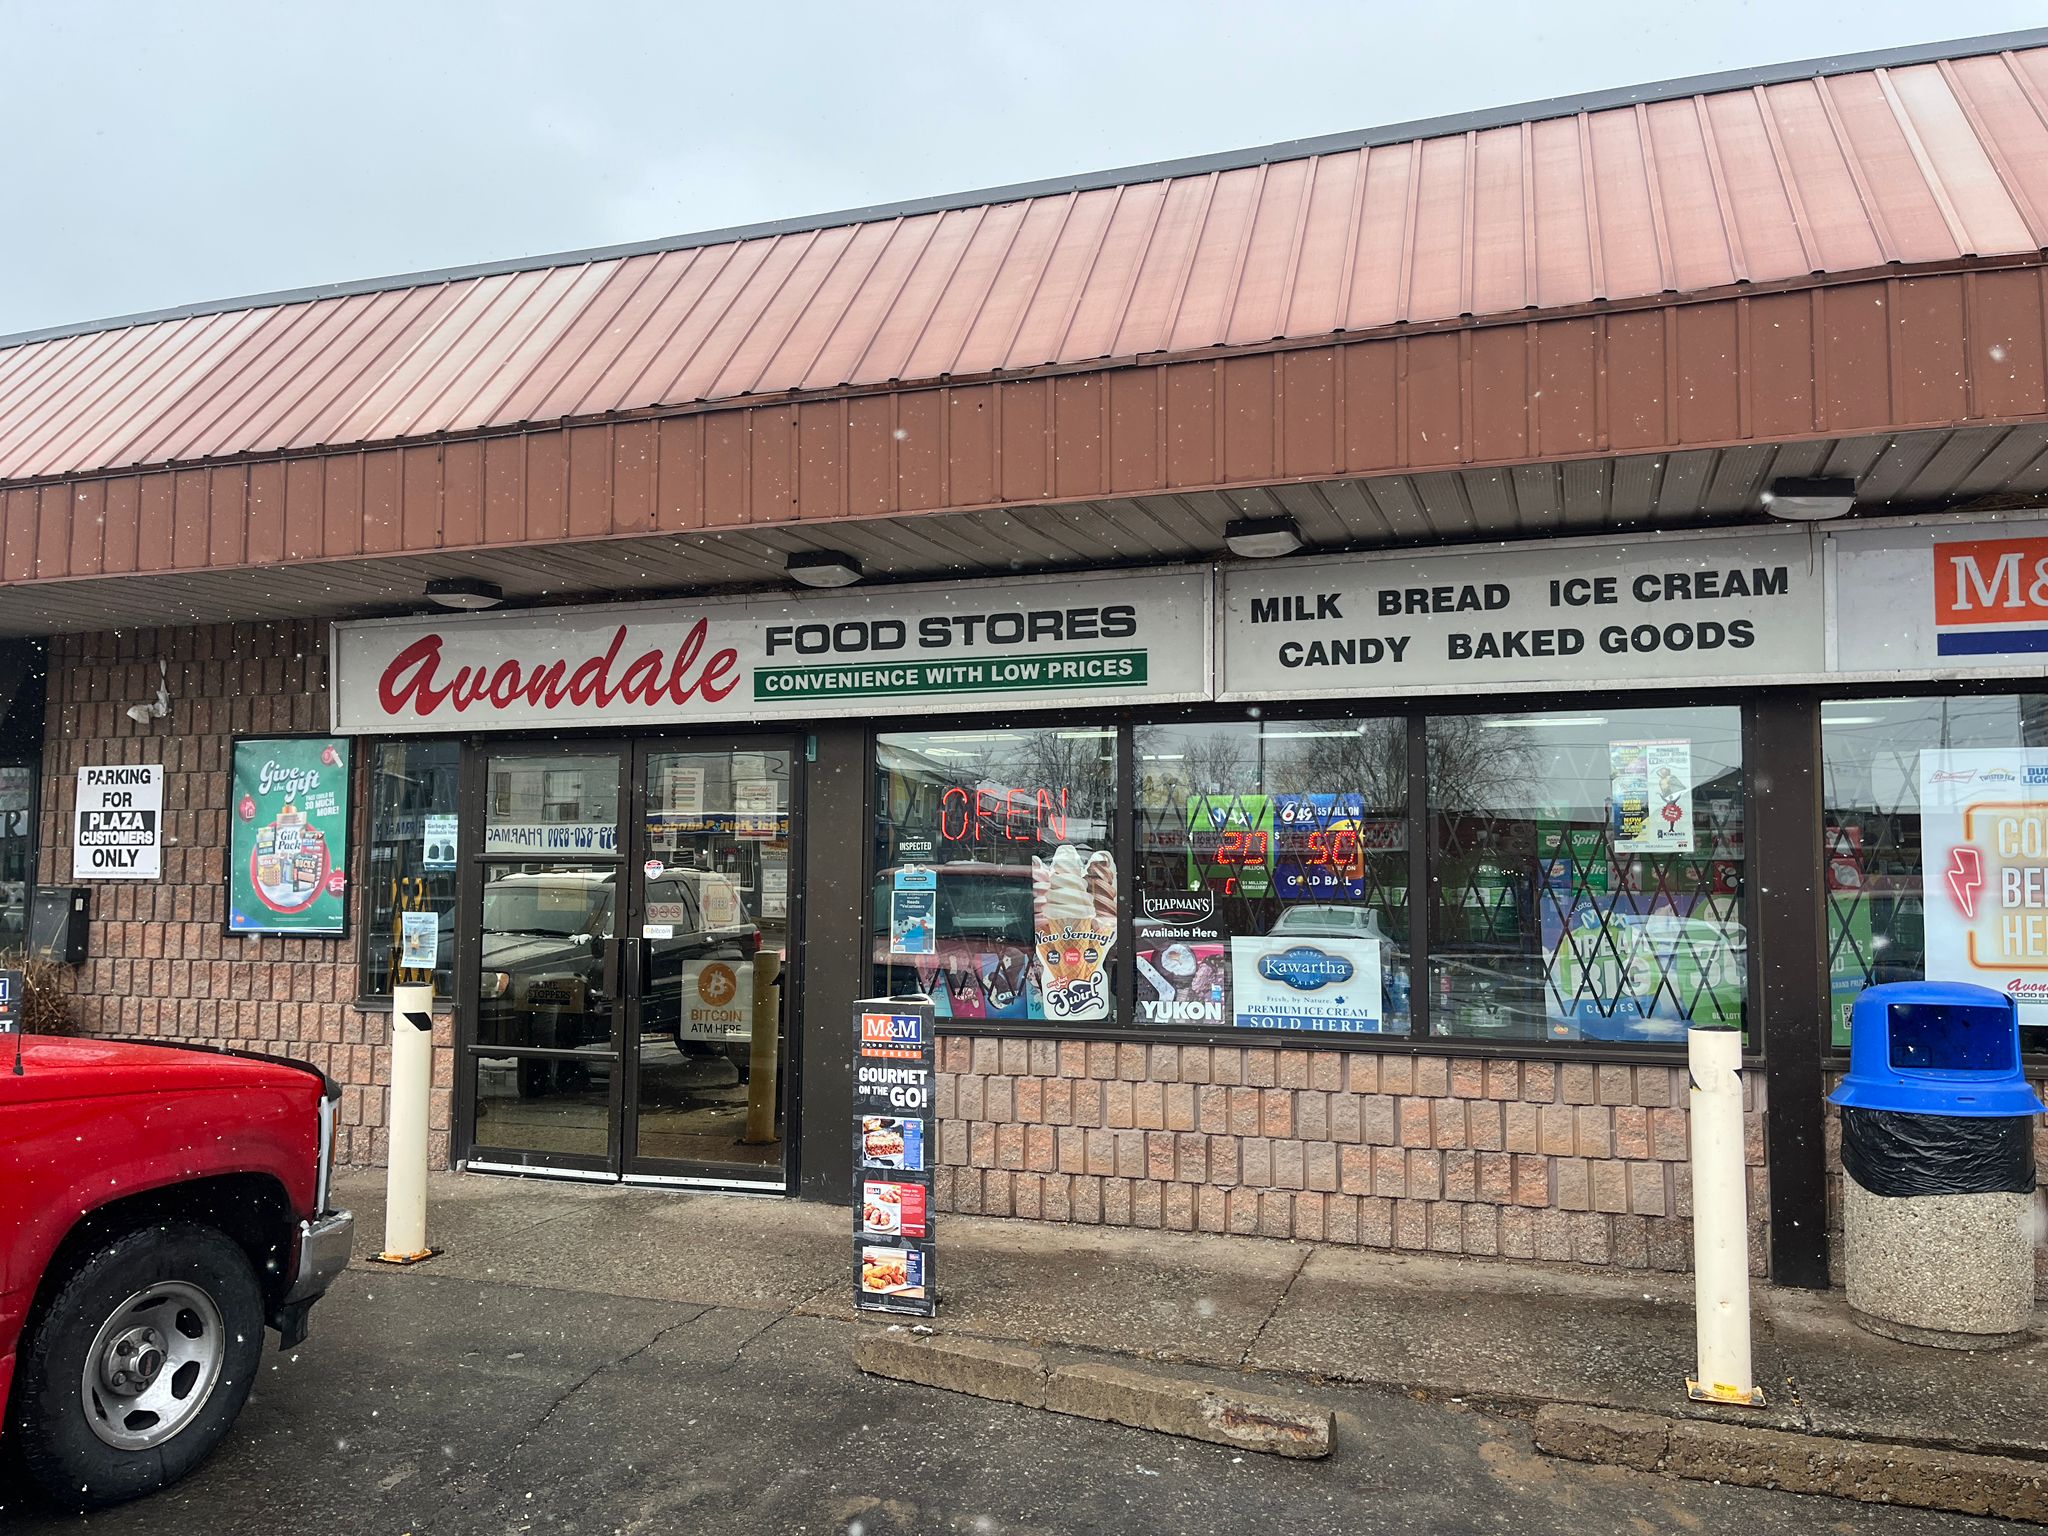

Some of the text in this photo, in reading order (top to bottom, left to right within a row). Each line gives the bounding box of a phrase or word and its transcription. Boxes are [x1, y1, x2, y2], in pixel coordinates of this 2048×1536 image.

[1250, 566, 1788, 624] MILK BREAD ICE CREAM
[765, 604, 1137, 657] FOOD STORES
[1278, 619, 1755, 669] CANDY BAKED GOODS
[378, 616, 740, 716] Avondale
[765, 658, 1133, 692] CONVENIENCE WITH LOW PRICES
[87, 768, 151, 785] PARKING
[258, 760, 300, 795] Give
[284, 769, 321, 803] gift
[102, 791, 132, 808] FOR
[305, 798, 335, 810] SO MUCH
[316, 806, 339, 817] MORE!
[941, 787, 1068, 841] OPEN
[89, 812, 145, 830] PLAZA
[80, 830, 154, 845] CUSTOMERS
[280, 830, 299, 841] Gift
[1998, 817, 2048, 859] CO
[278, 840, 301, 850] Pack
[899, 842, 932, 851] INSPECTED
[1306, 831, 1356, 865] 50
[92, 848, 139, 868] ONLY
[1324, 875, 1352, 886] BAL
[1146, 897, 1210, 913] CHAPMAN'S
[1574, 902, 1592, 912] Lotto
[1035, 925, 1115, 947] Now Serving!
[1141, 927, 1218, 938] Available Here
[2002, 915, 2048, 957] HE
[1265, 958, 1347, 976] Kawartha
[1290, 977, 1321, 986] DAIRY
[1570, 957, 1652, 1000] BIG
[528, 989, 572, 999] STOPPERS
[1046, 970, 1105, 1017] Swirl
[1291, 996, 1301, 1005] by
[691, 1009, 742, 1022] BITCOIN
[1141, 1001, 1222, 1020] YUKON
[1247, 1005, 1368, 1017] PREMIUM ICE CREAM
[691, 1023, 741, 1034] ATM HERE
[866, 1018, 917, 1039] M&M
[1250, 1016, 1365, 1031] SOLD HERE
[867, 1049, 917, 1057] EXPRESS
[858, 1066, 928, 1085] GOURMET
[858, 1085, 928, 1108] ON THE GO!
